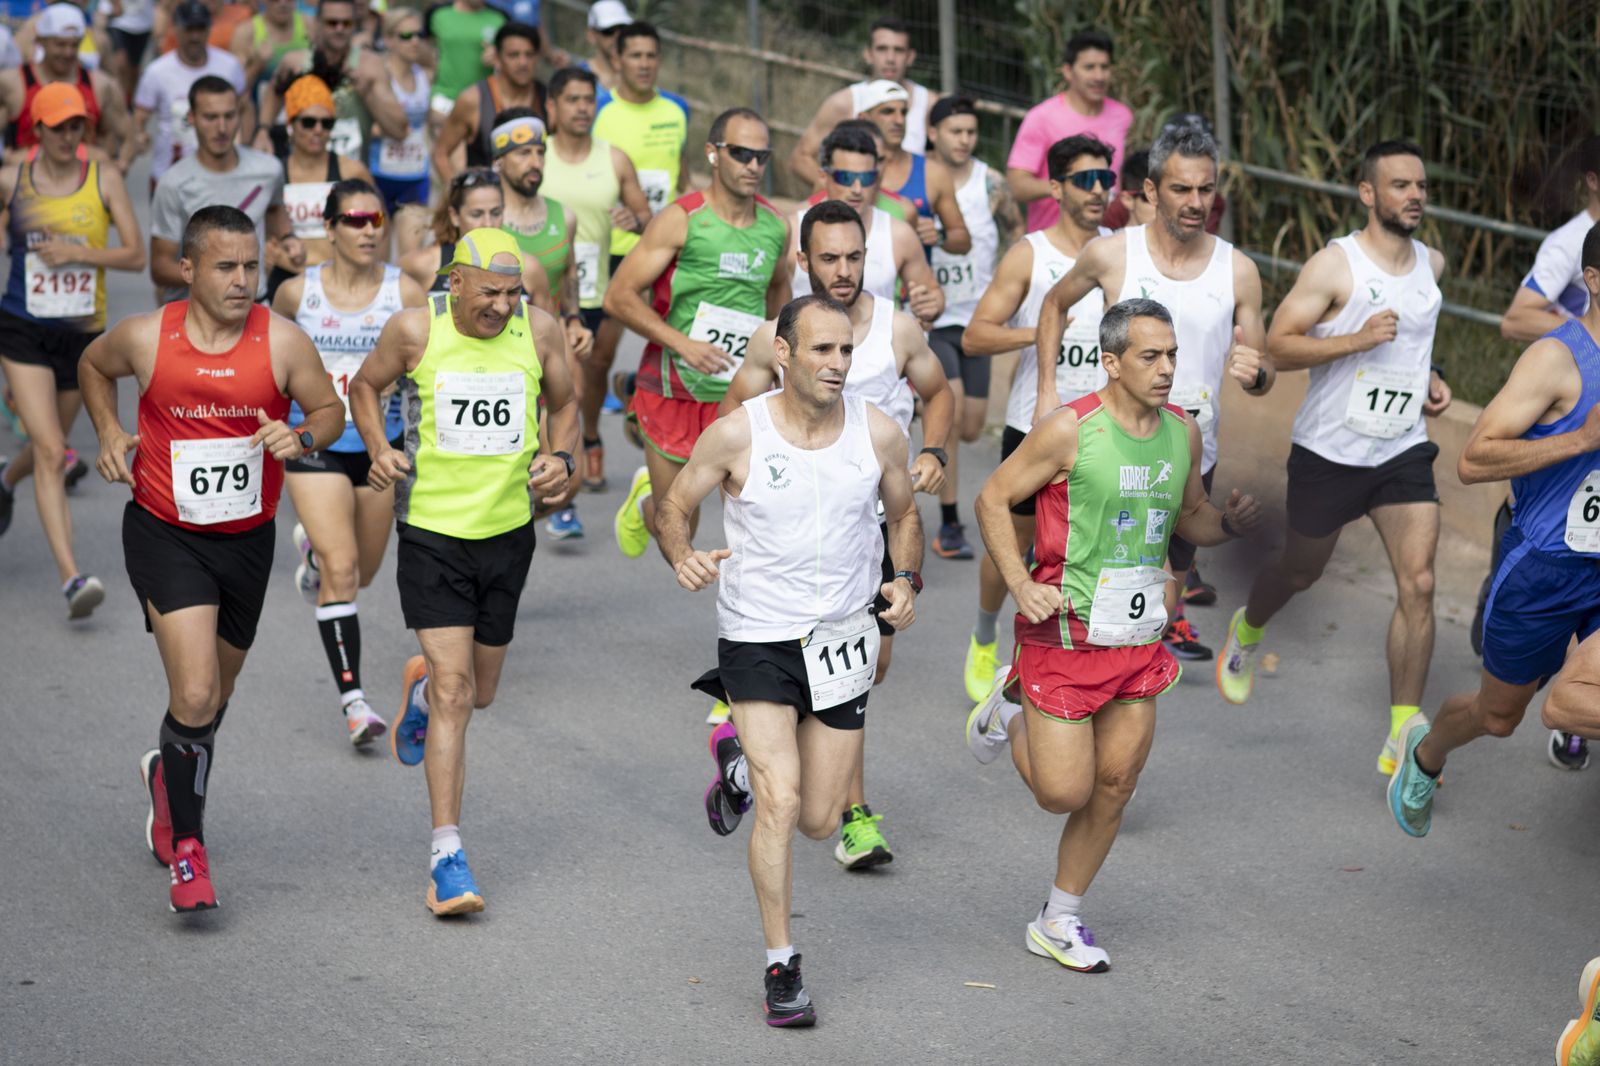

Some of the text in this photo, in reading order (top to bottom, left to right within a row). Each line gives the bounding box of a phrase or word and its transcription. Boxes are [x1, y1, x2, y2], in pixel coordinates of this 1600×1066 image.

[32, 272, 92, 294] 2192
[707, 328, 750, 358] 252
[169, 402, 260, 419] WadiÁndalu
[451, 398, 511, 427] 766
[1366, 387, 1414, 416] 177
[189, 463, 250, 495] 679
[1120, 465, 1150, 490] ATARFE
[1128, 592, 1146, 620] 9
[818, 635, 868, 676] 111
